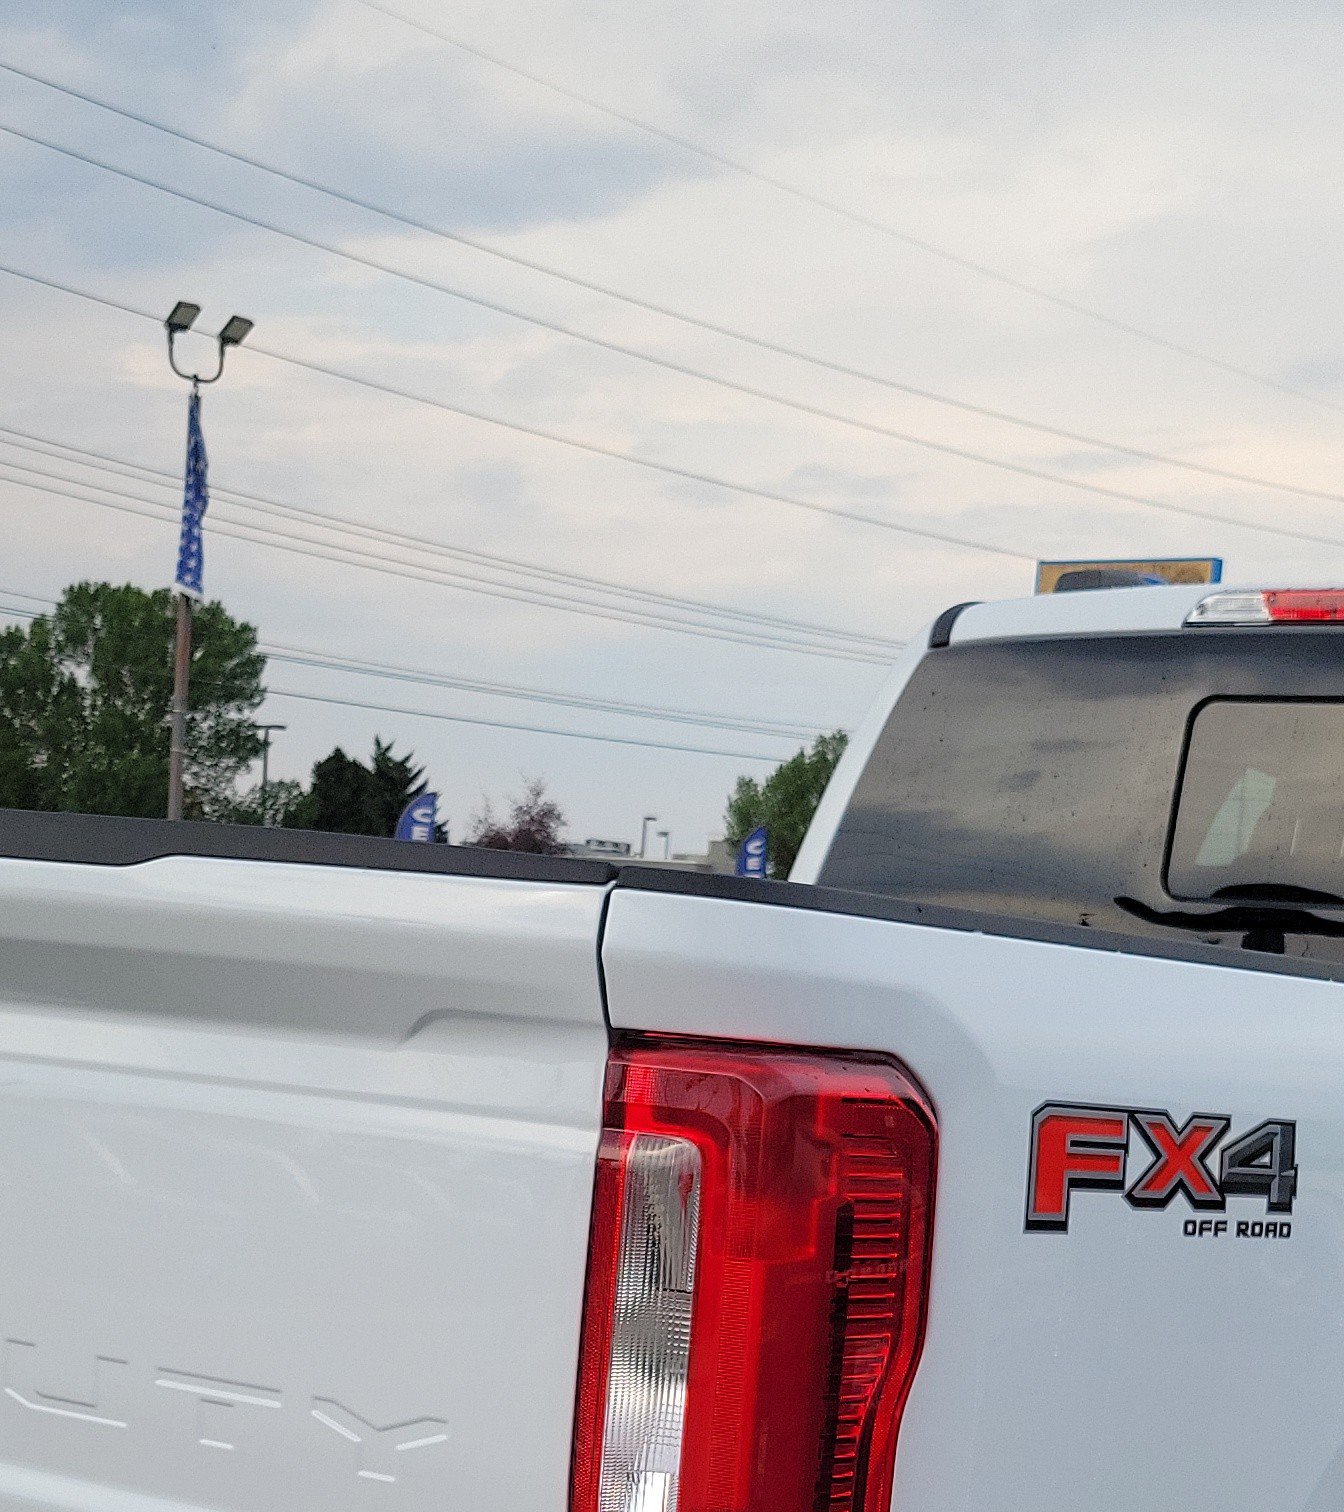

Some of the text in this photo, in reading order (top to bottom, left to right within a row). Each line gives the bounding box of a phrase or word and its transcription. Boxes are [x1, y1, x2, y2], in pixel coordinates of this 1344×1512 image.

[1023, 1100, 1298, 1234] FX4
[1182, 1219, 1293, 1239] OFF ROAD
